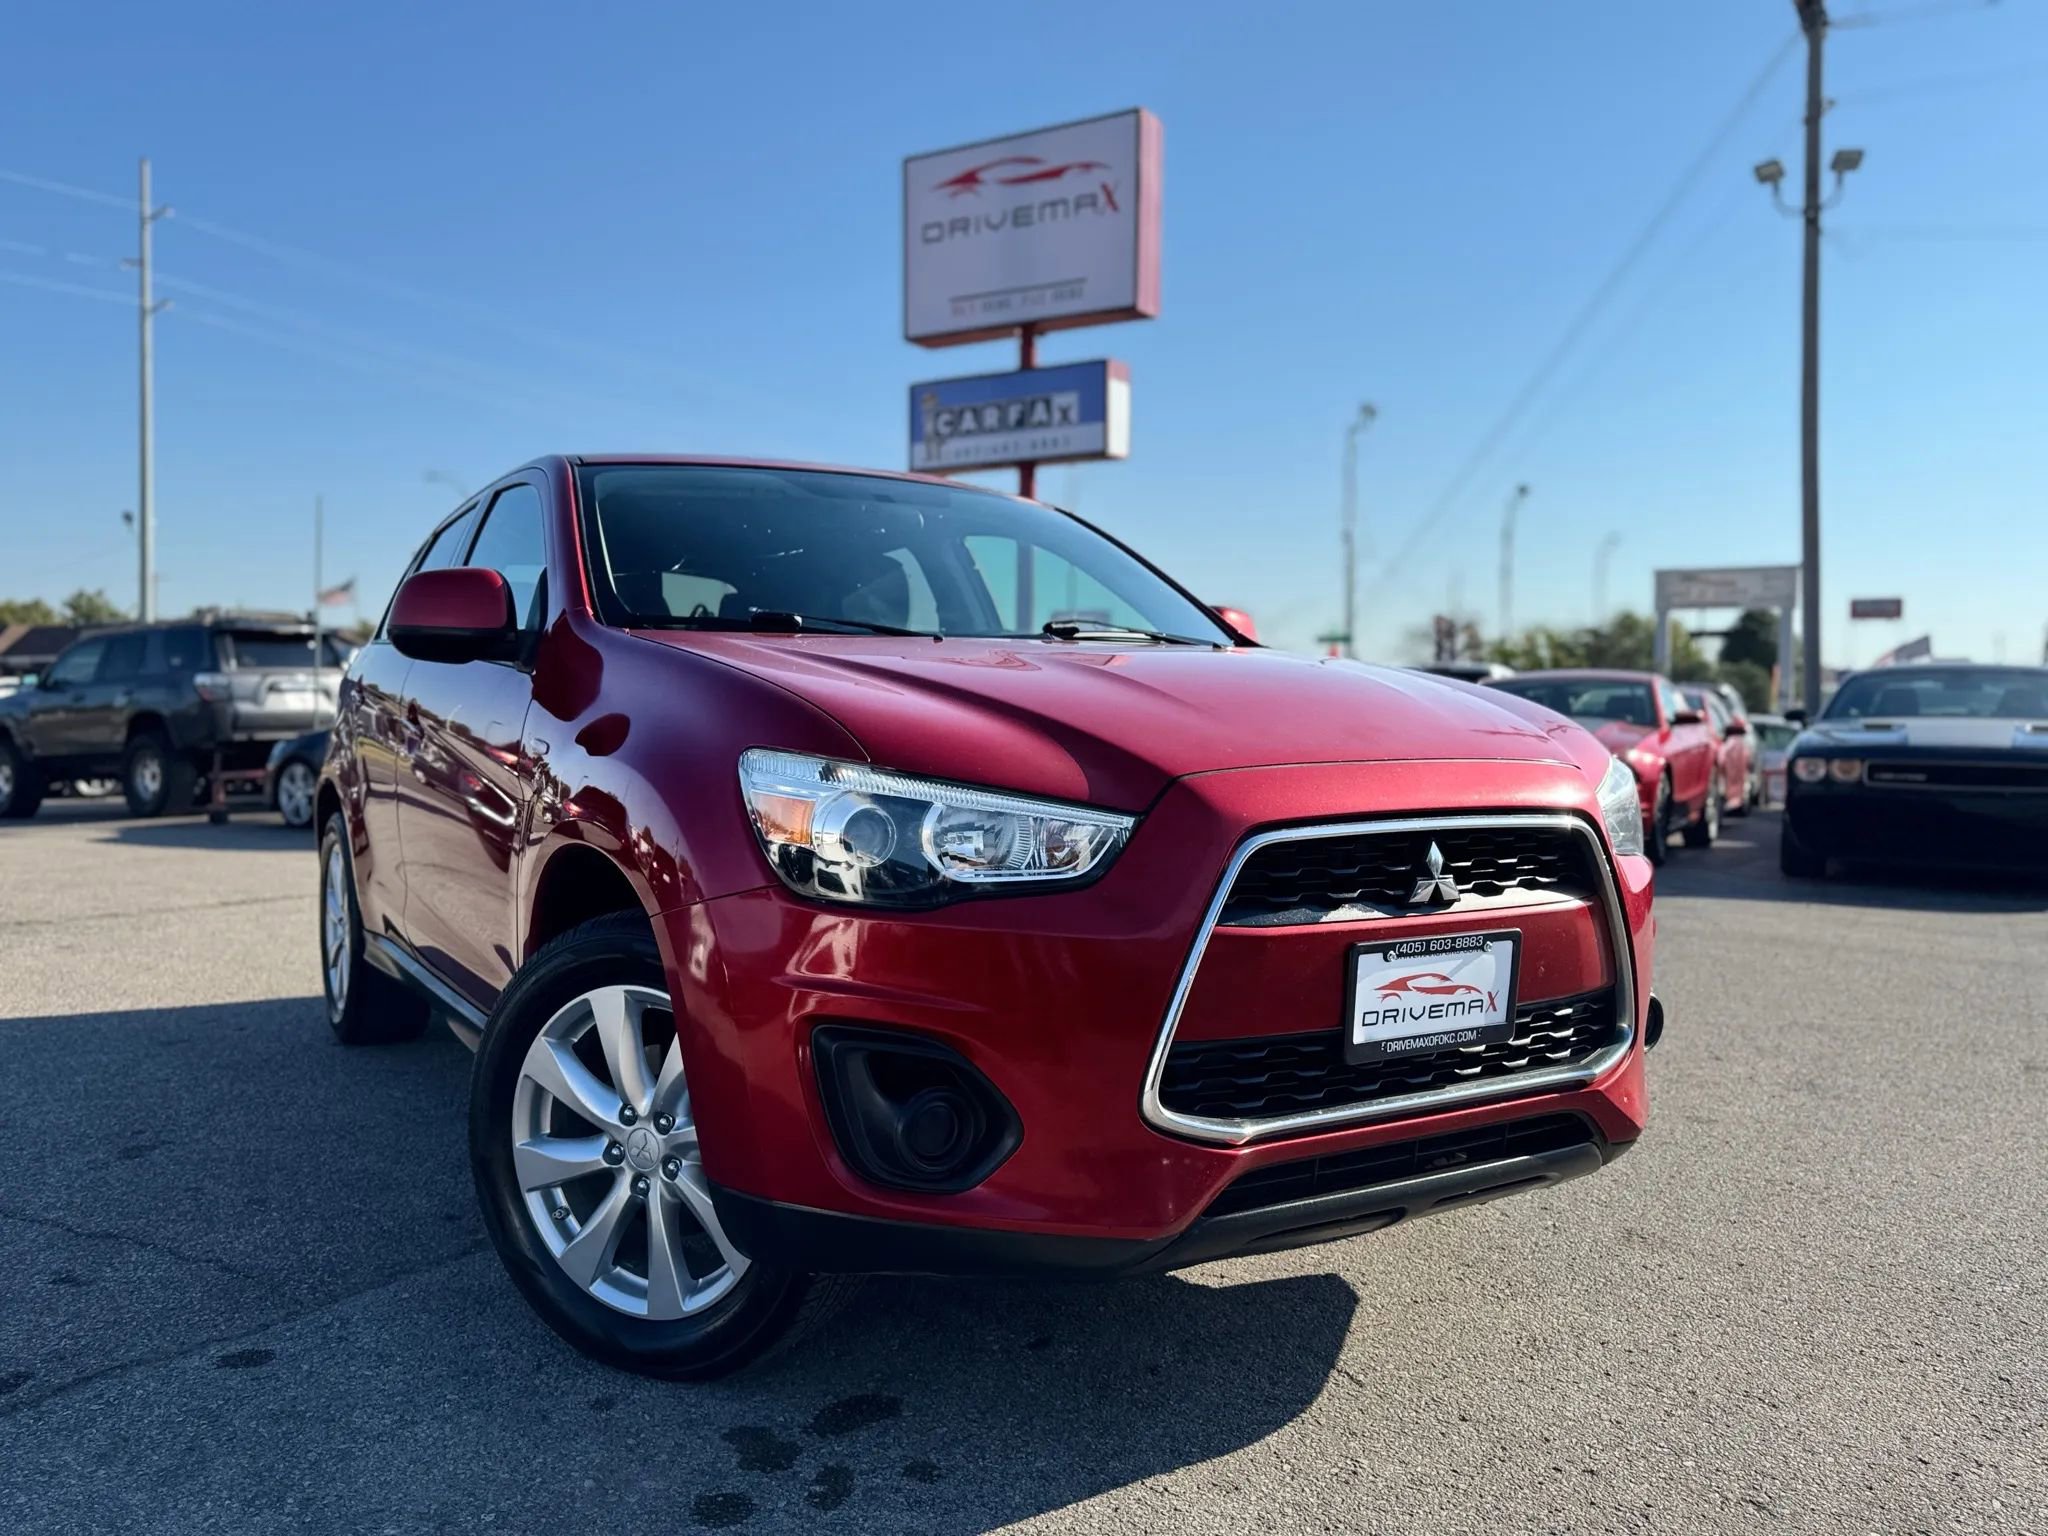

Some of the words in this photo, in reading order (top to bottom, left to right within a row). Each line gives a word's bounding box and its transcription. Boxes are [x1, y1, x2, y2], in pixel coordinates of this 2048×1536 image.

[920, 181, 1120, 245] DRIVEMAX
[935, 395, 1077, 436] CARFAX
[1395, 941, 1426, 955] (405)
[1429, 935, 1484, 951] 603-8883
[1361, 990, 1500, 1027] DRIVEMAX
[1386, 1031, 1477, 1053] DRIVEMAXOFOKC.COM
